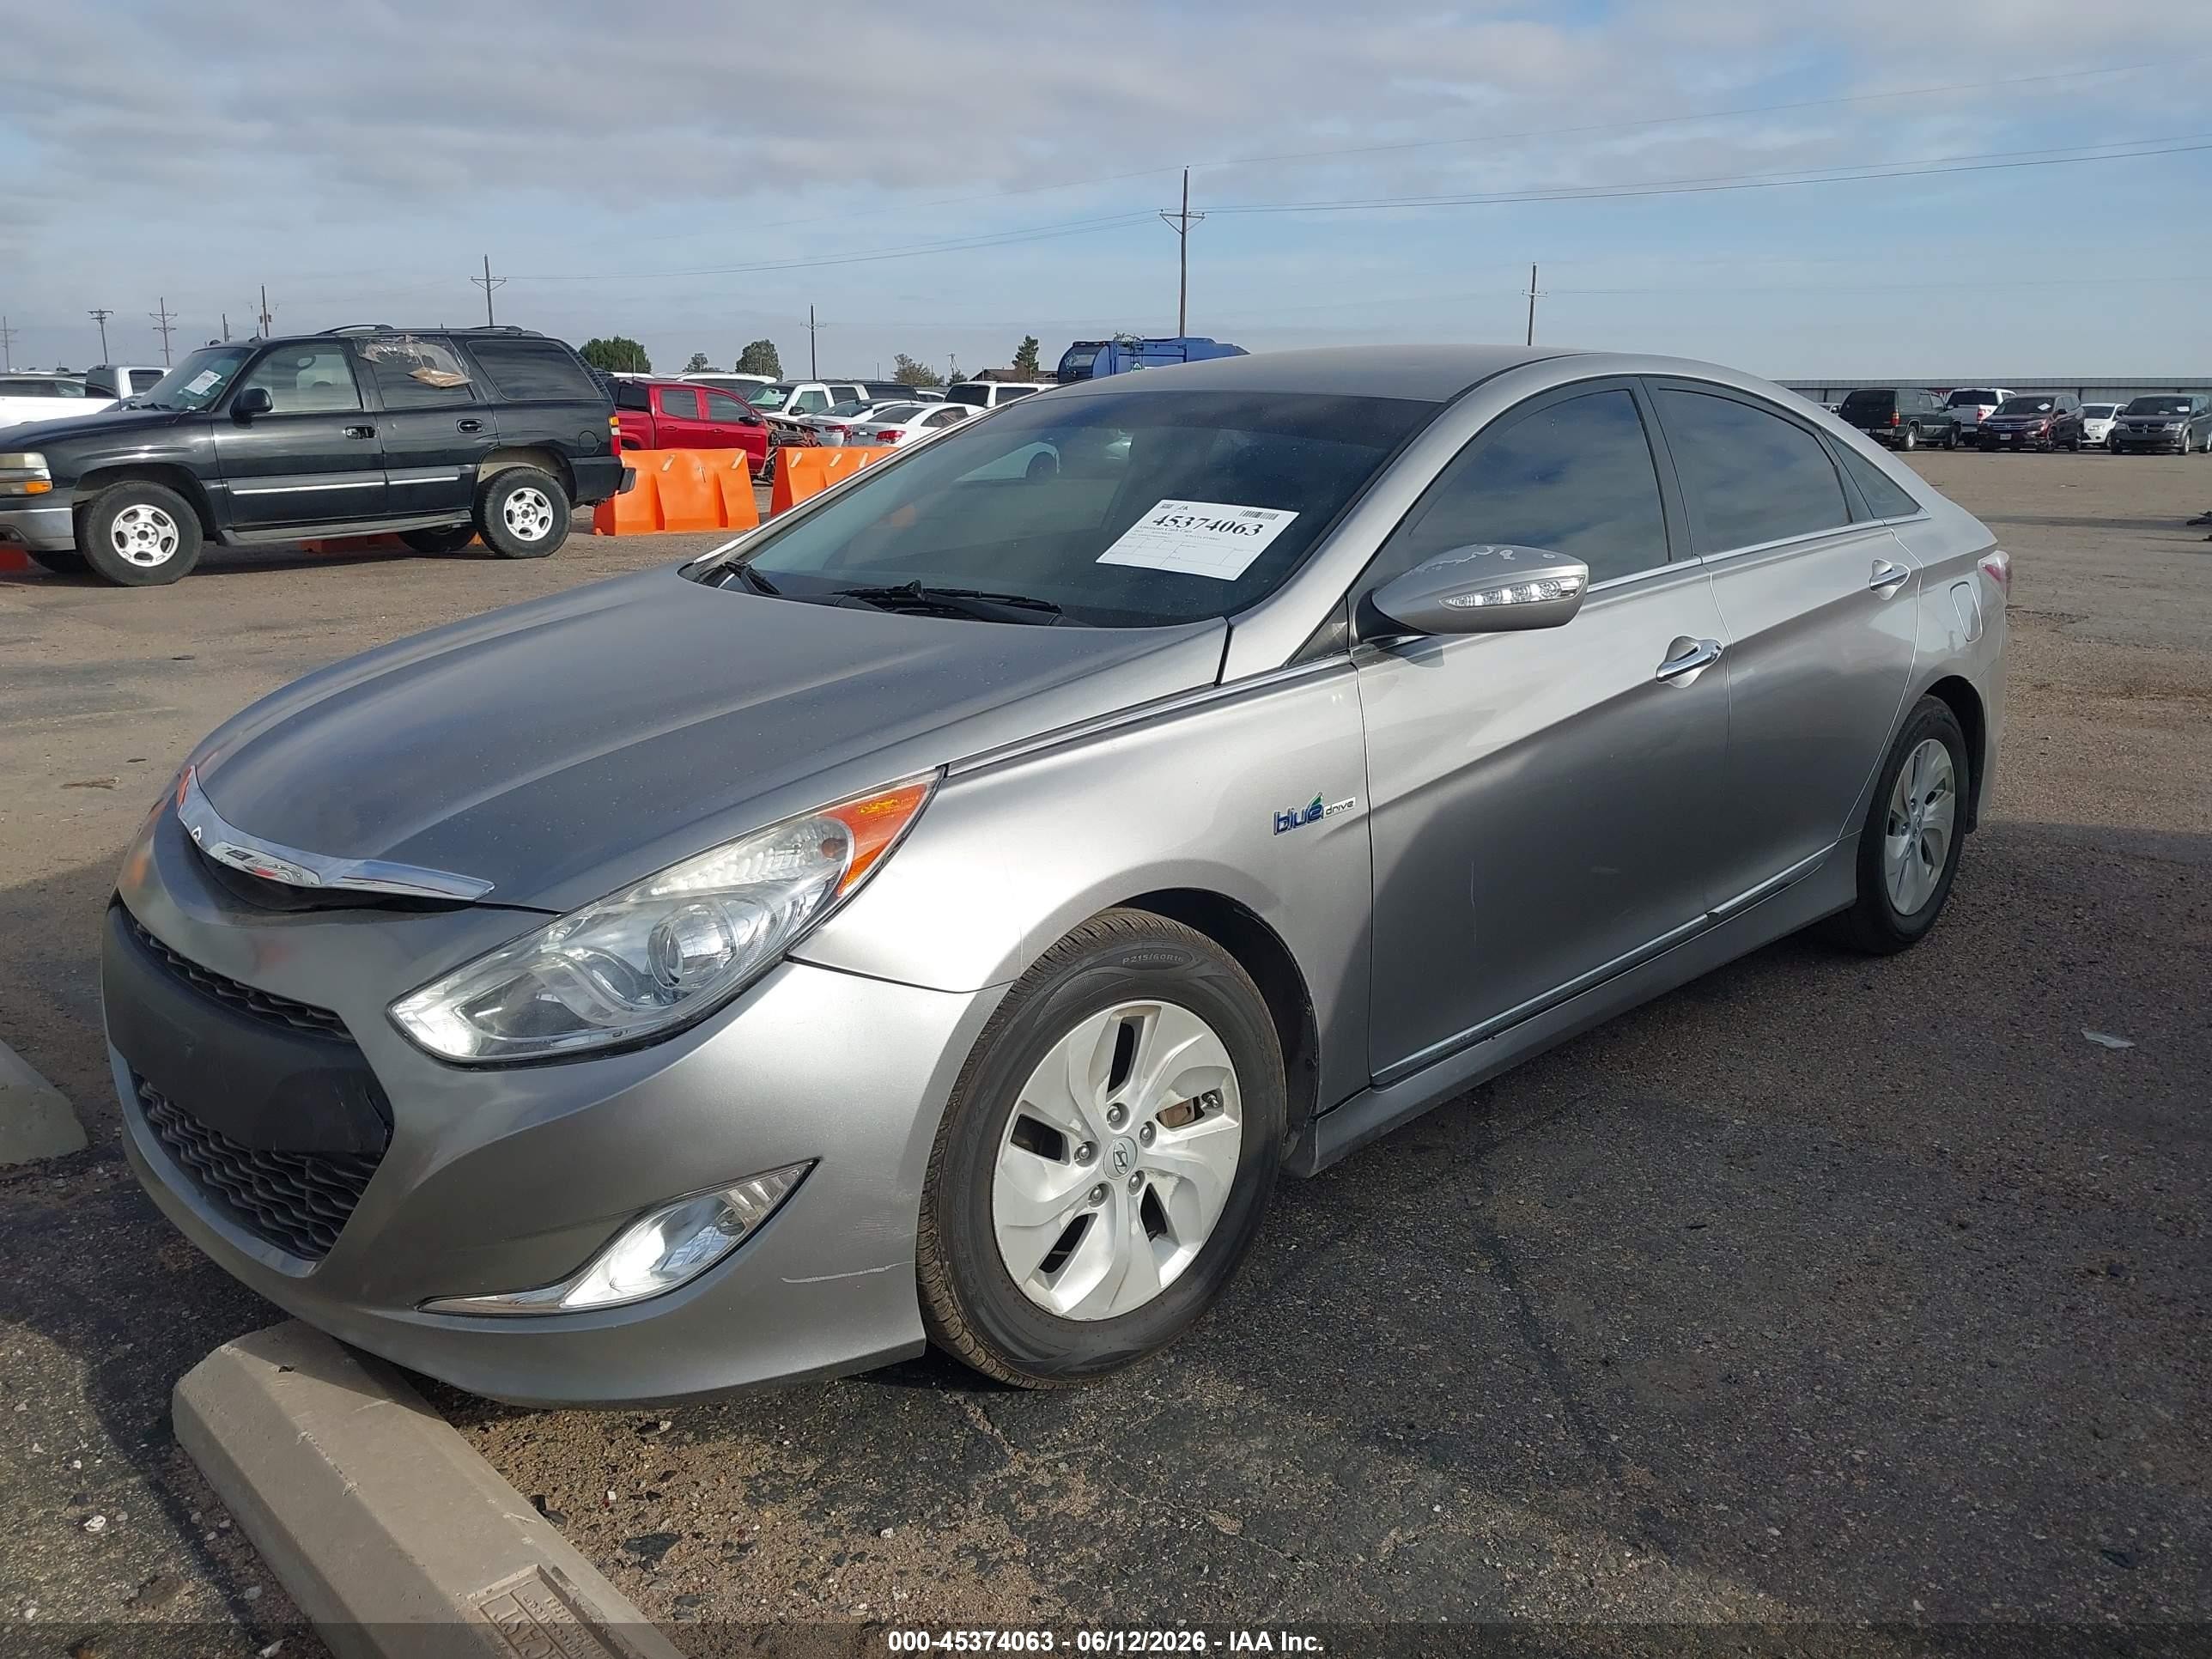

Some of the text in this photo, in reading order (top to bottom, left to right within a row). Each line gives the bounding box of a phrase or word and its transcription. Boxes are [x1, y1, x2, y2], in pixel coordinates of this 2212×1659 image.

[1152, 514, 1264, 536] 45374063
[1273, 799, 1354, 836] blue drive
